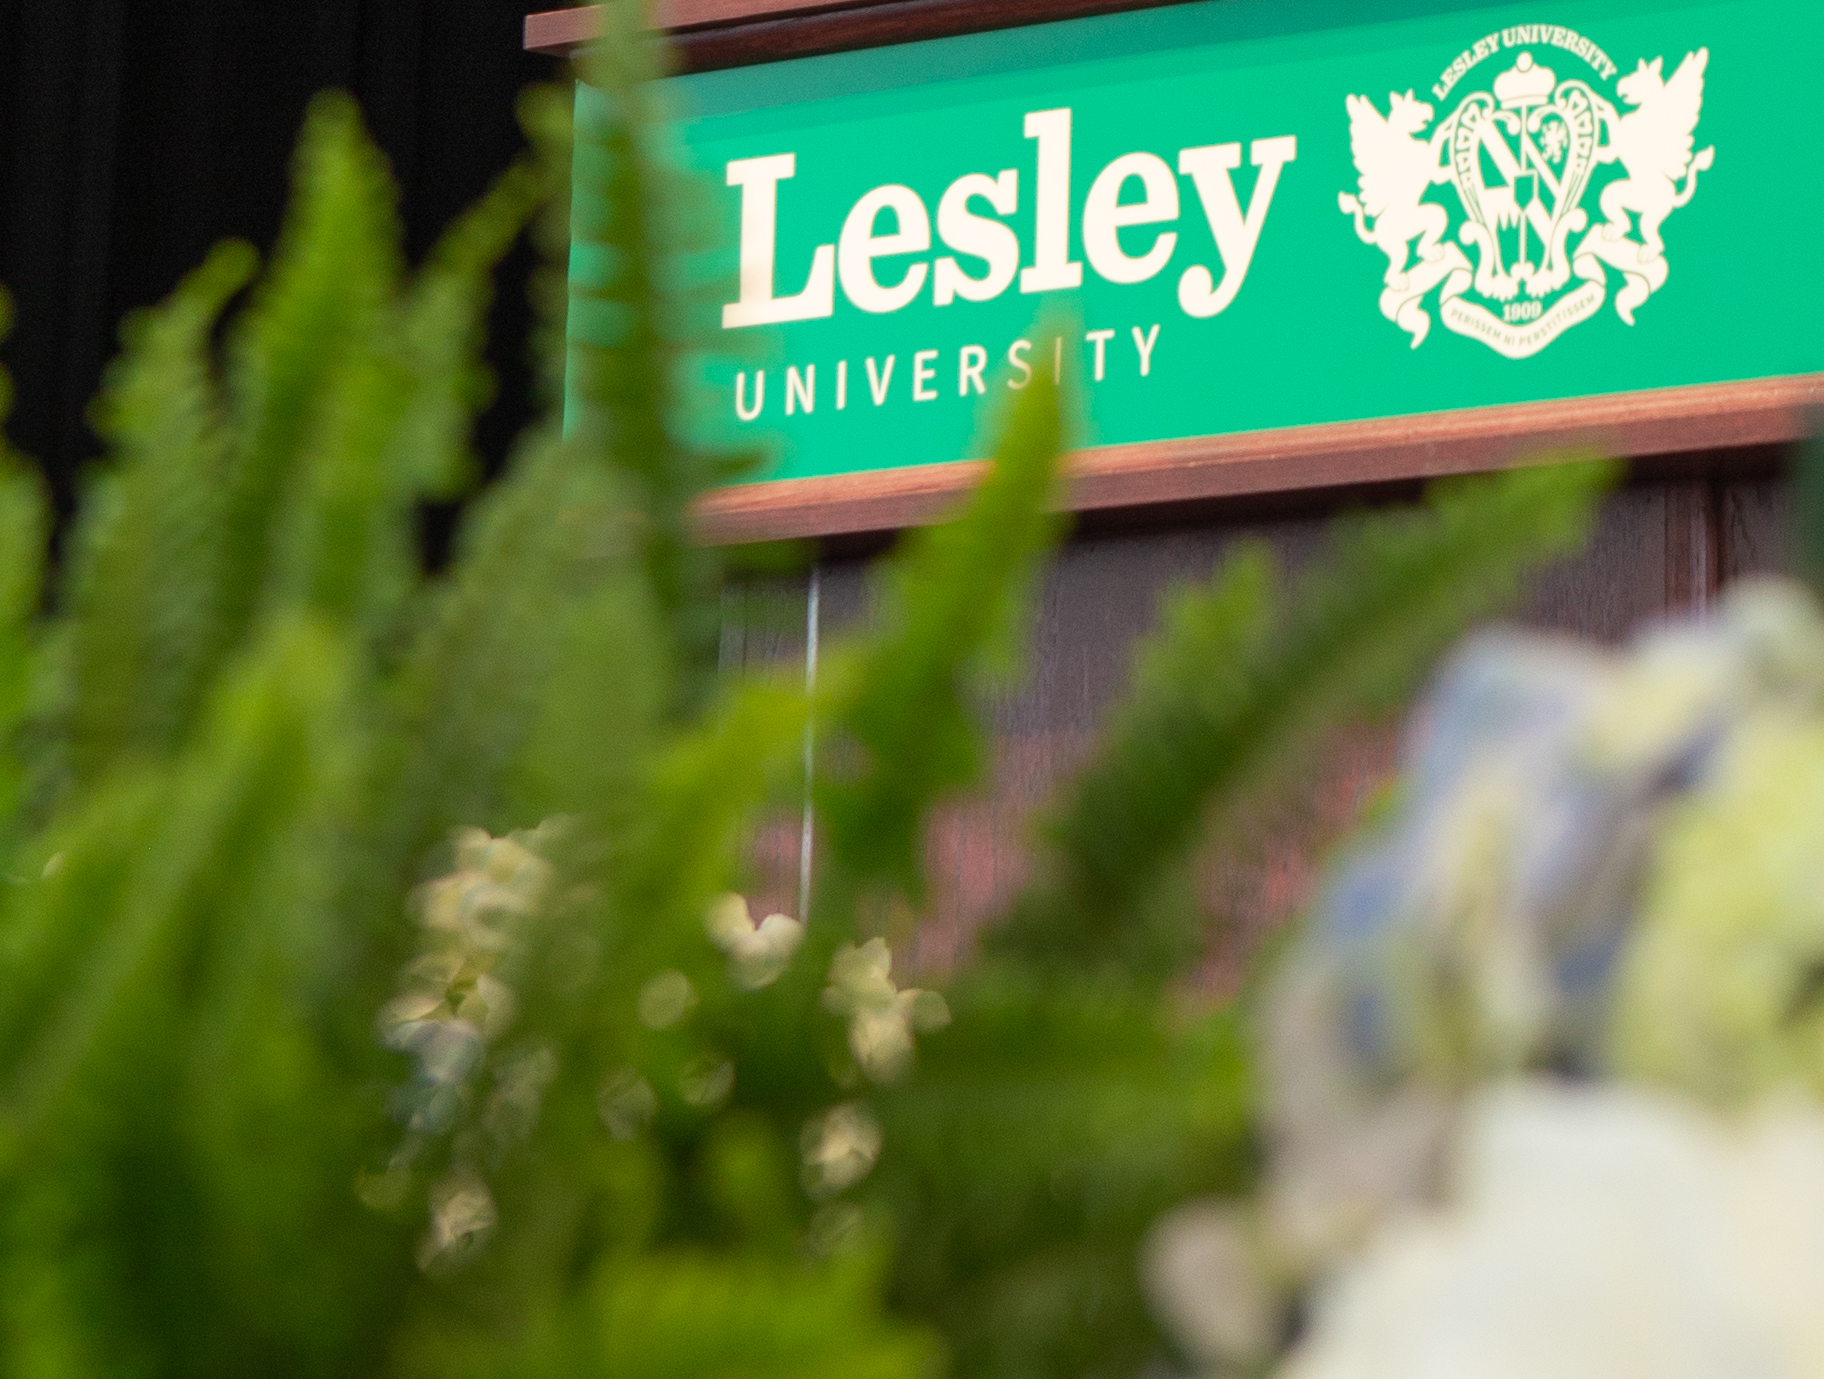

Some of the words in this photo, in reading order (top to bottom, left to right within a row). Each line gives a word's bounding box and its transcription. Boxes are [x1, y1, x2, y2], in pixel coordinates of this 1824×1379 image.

[1432, 32, 1500, 102] LESLEY
[1501, 23, 1618, 81] UNIVERSITY
[722, 107, 1297, 329] Lesley
[1450, 307, 1502, 340] PERISSEM
[1503, 301, 1543, 322] 1909
[734, 324, 1160, 420] UNIVERSITY
